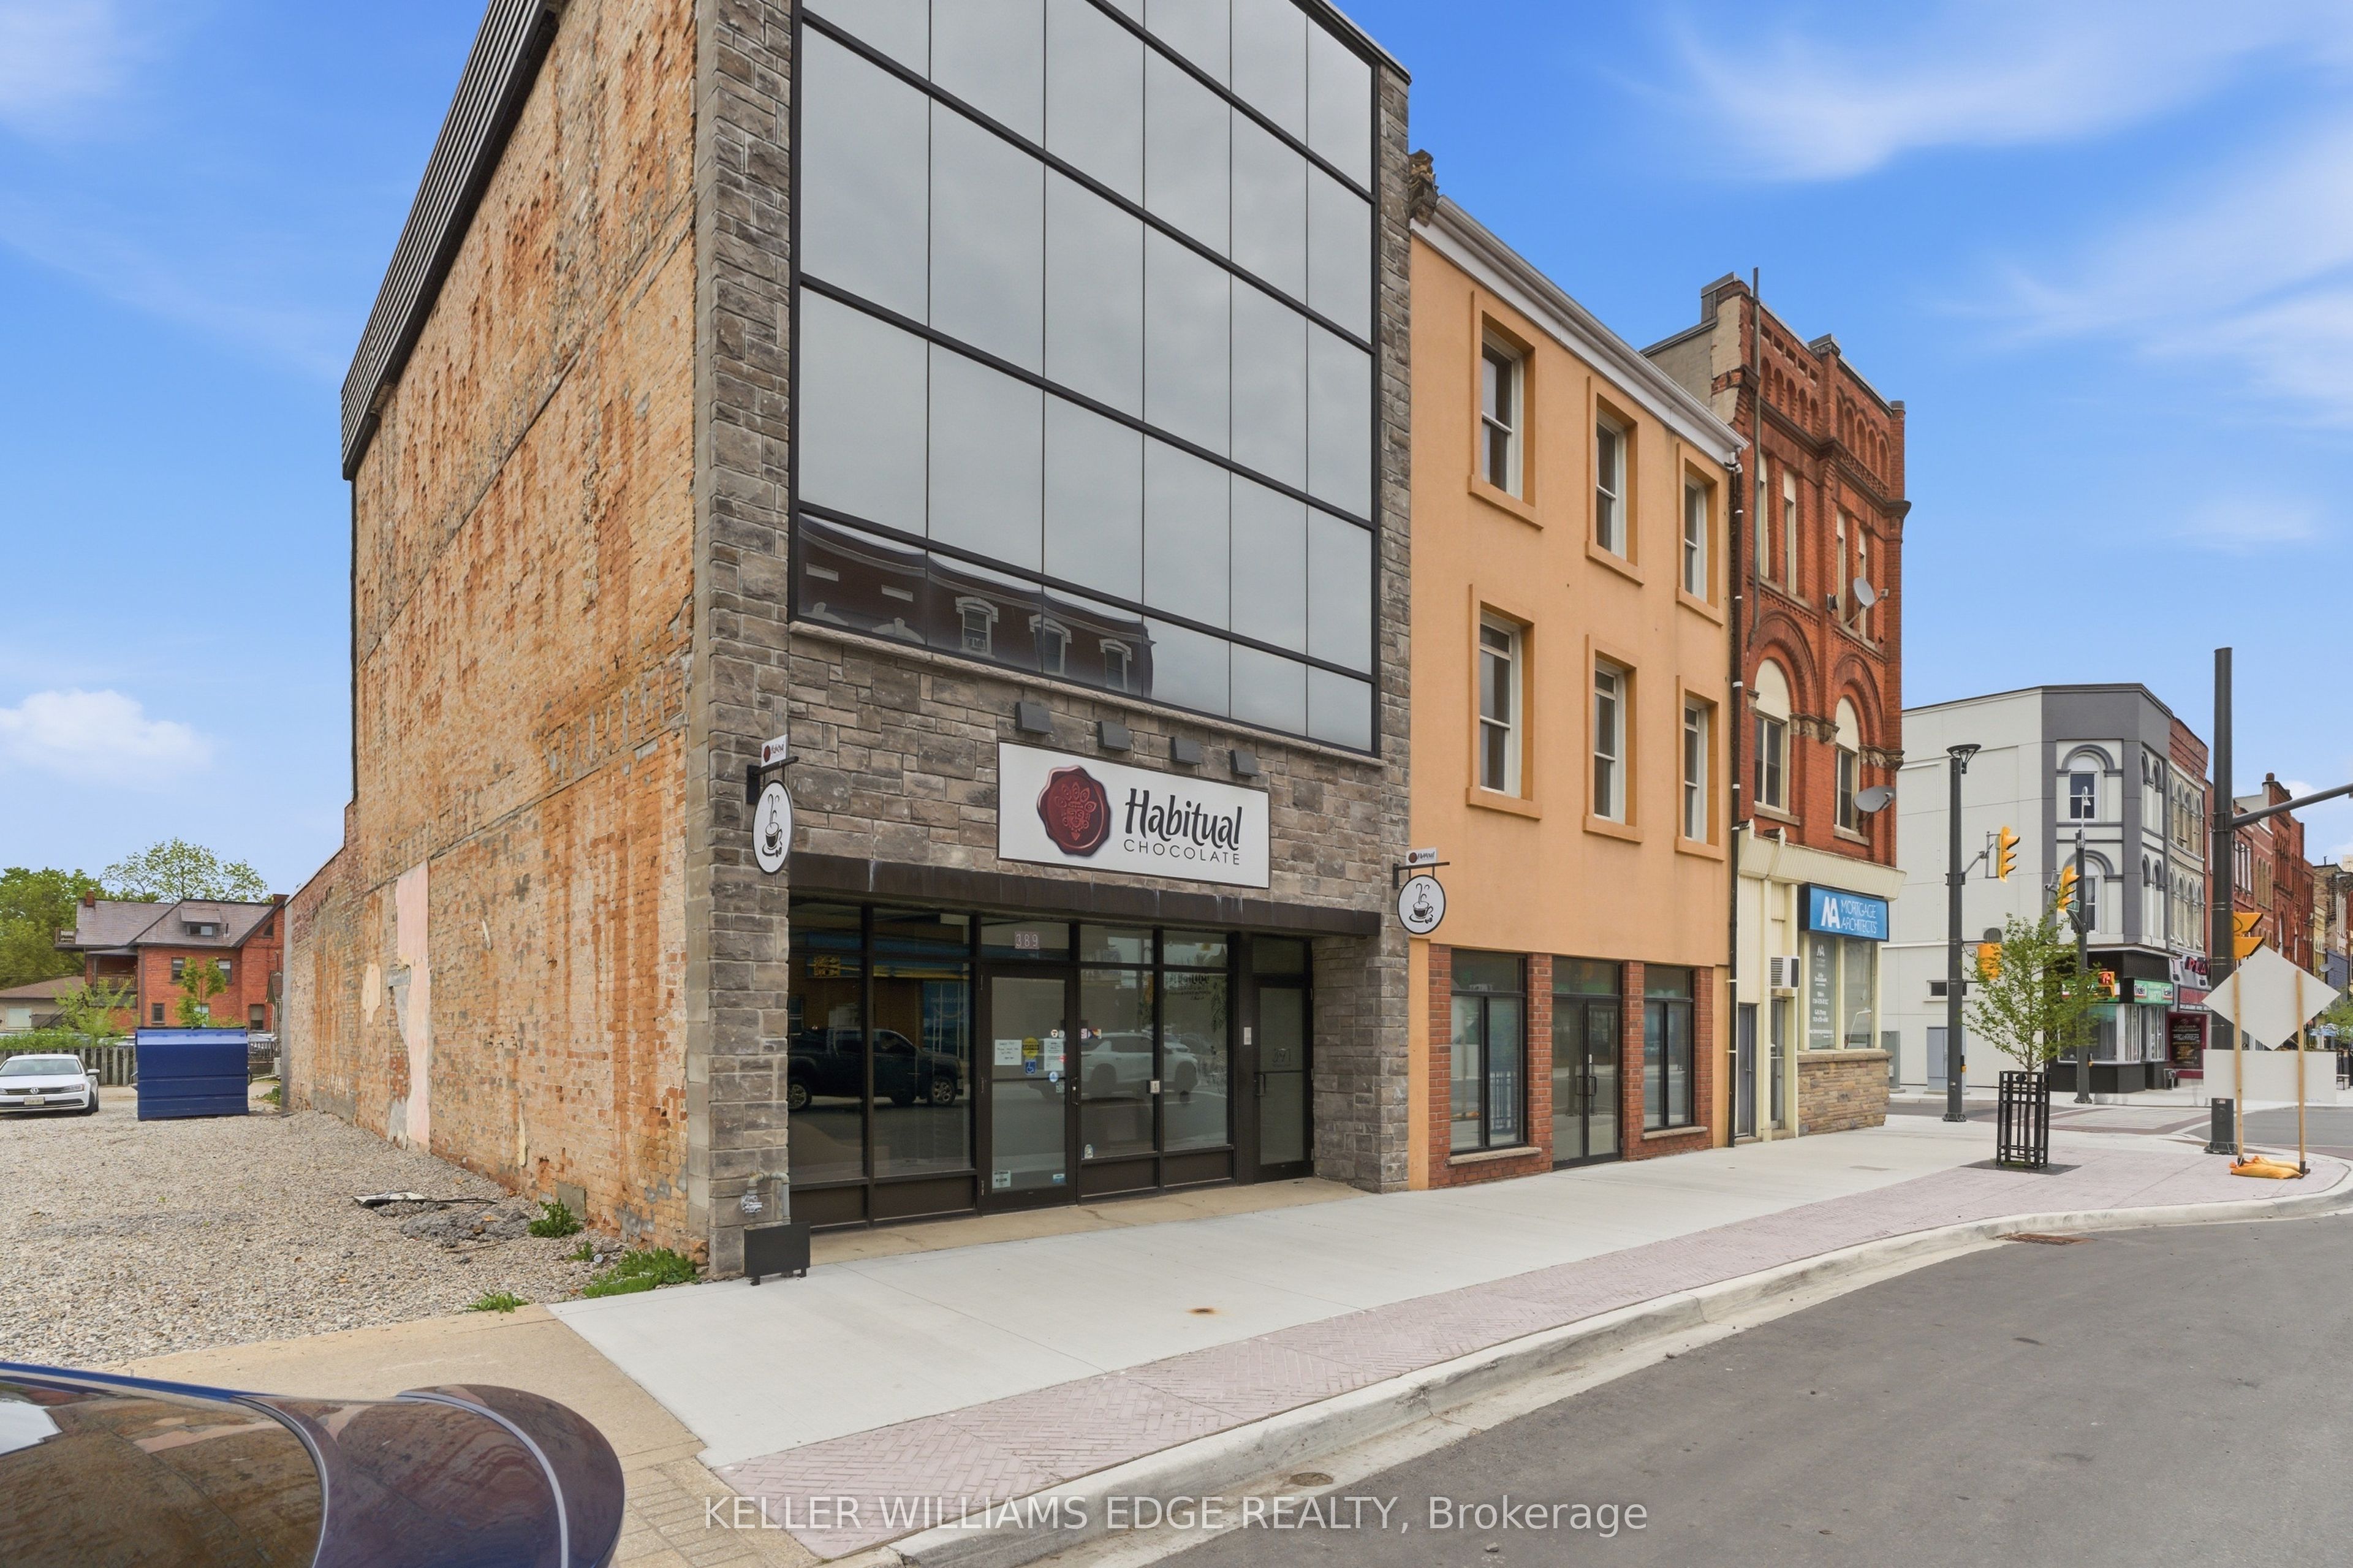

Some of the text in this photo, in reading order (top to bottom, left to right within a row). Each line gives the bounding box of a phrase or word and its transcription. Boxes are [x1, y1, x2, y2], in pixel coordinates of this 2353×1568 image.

[1124, 787, 1243, 851] Habitual
[1123, 839, 1240, 865] CHOCOLATE
[1841, 899, 1876, 919] MORTGAGE
[1015, 934, 1038, 947] 389
